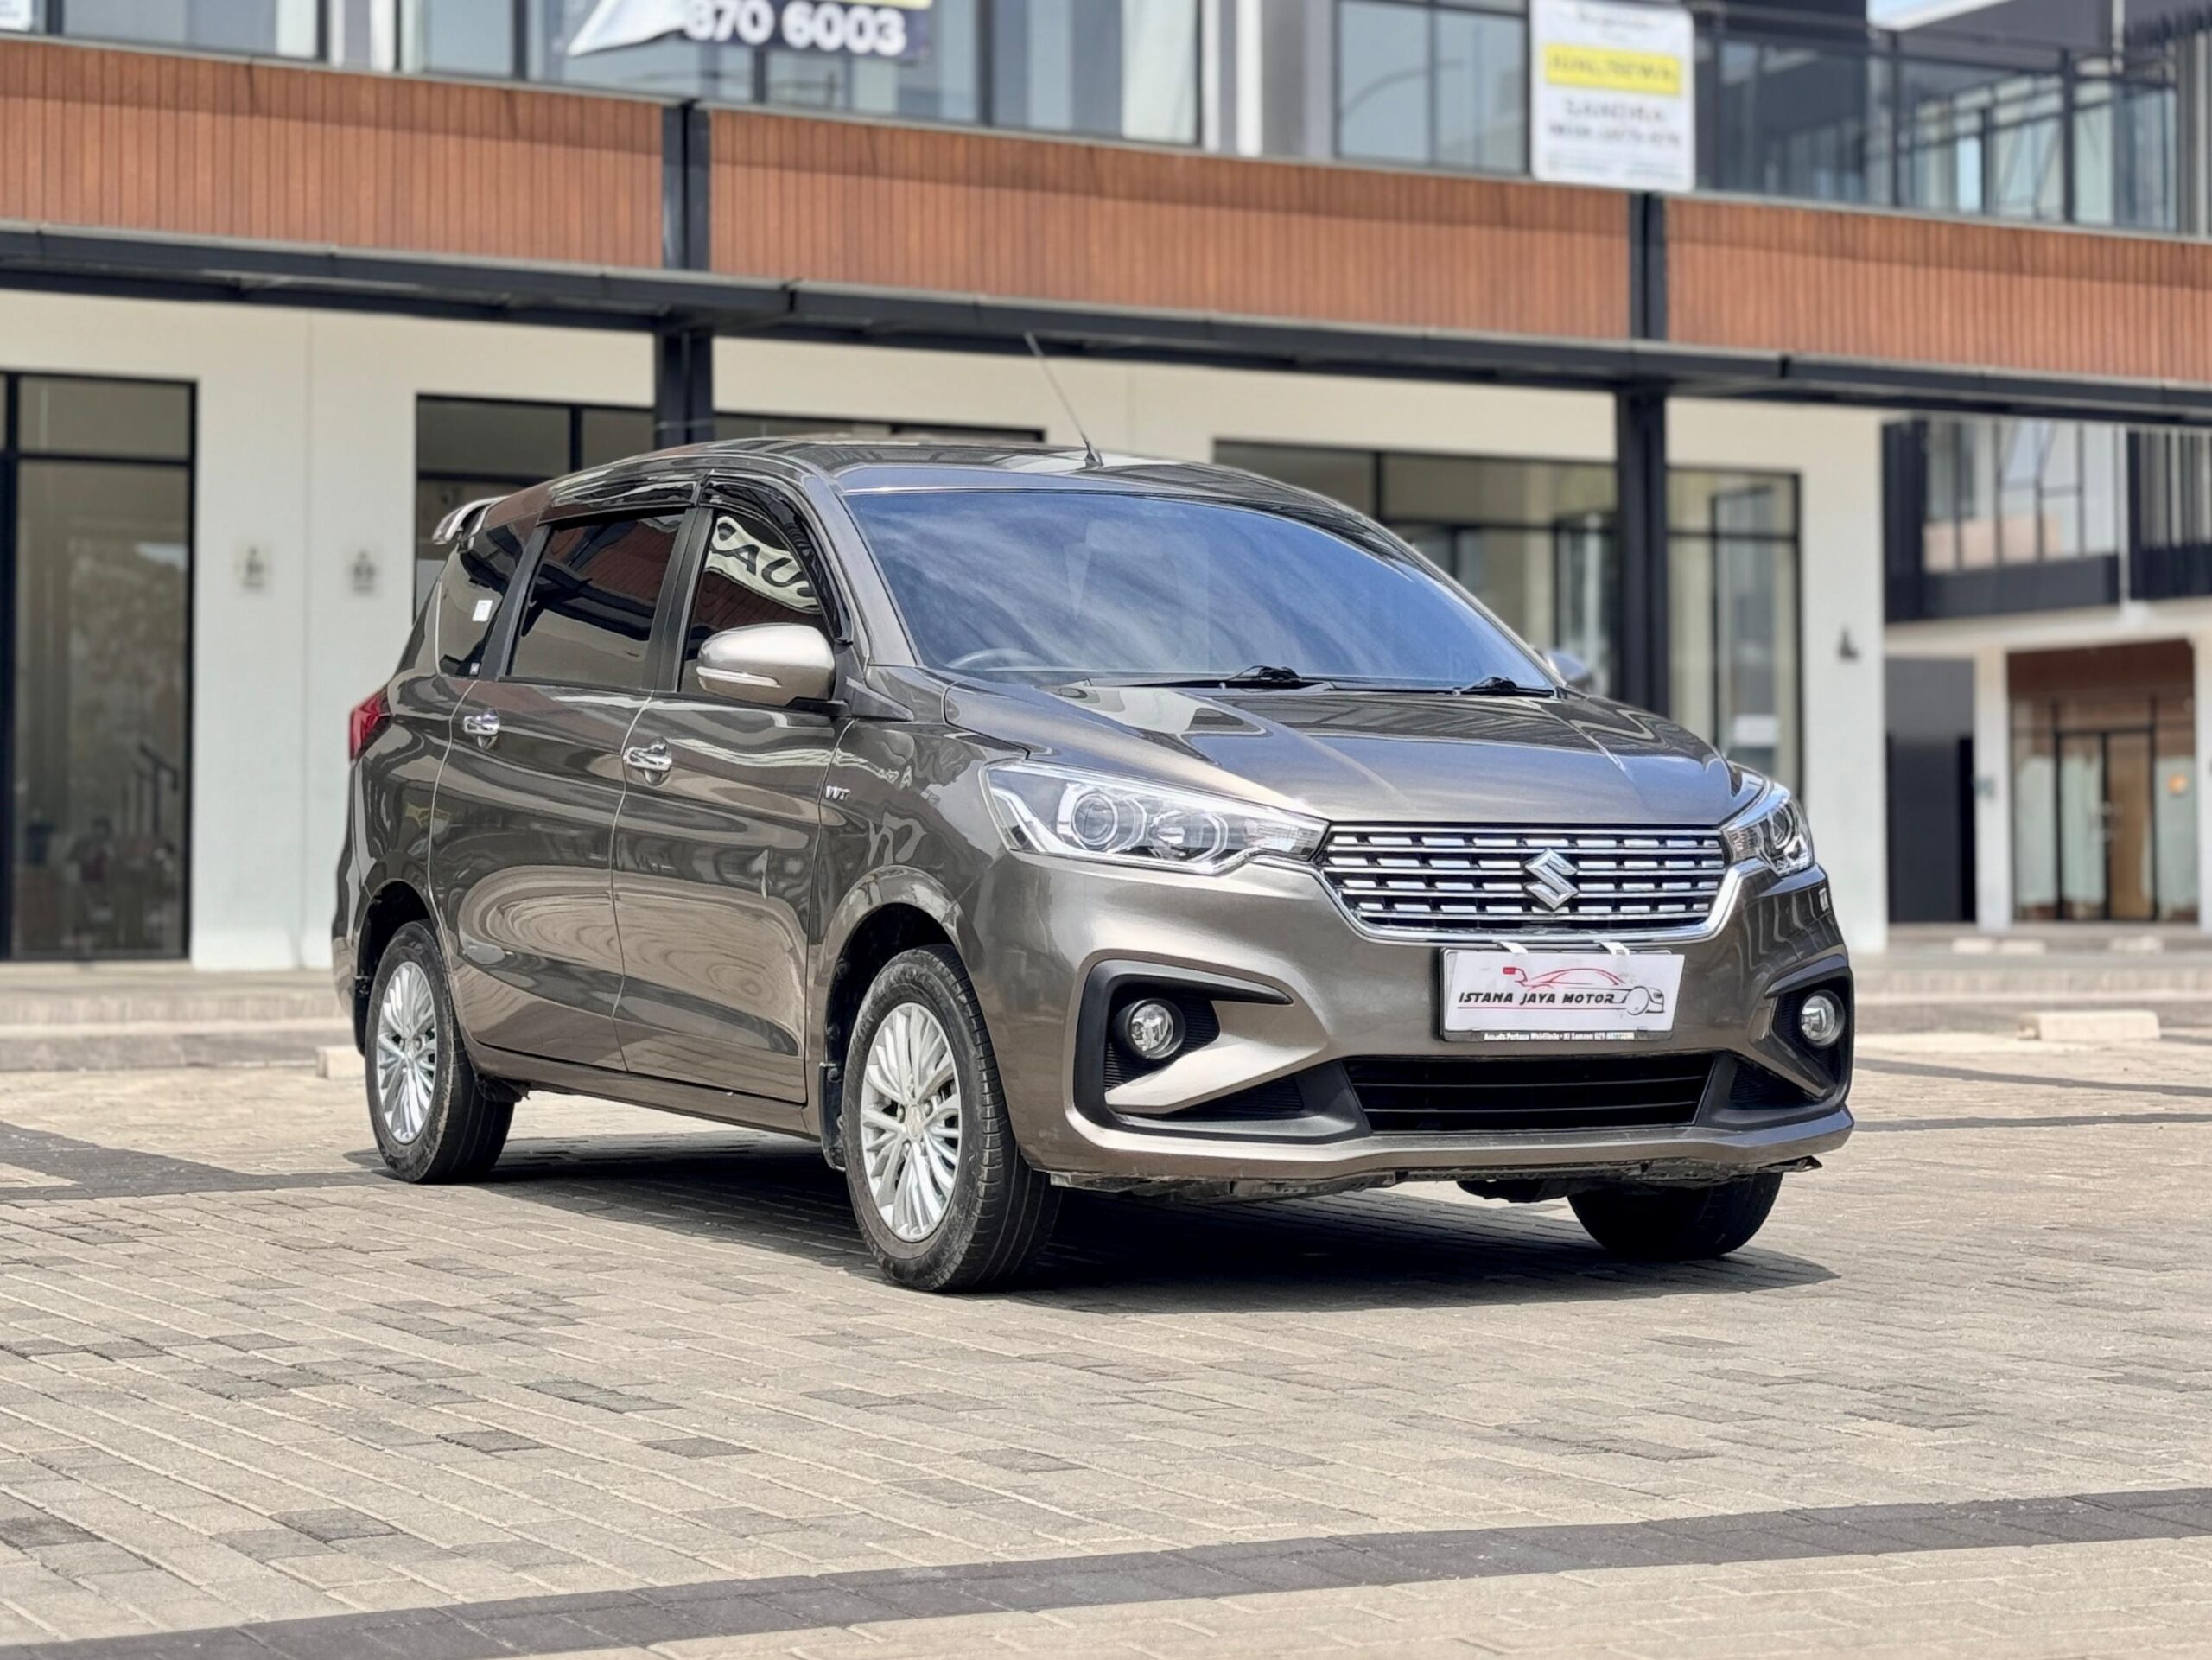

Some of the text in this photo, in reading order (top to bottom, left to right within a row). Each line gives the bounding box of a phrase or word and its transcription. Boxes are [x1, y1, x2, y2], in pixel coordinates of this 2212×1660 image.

[781, 1, 907, 56] 6003
[1459, 992, 1616, 1005] ISTANA JAYA MOTOR
